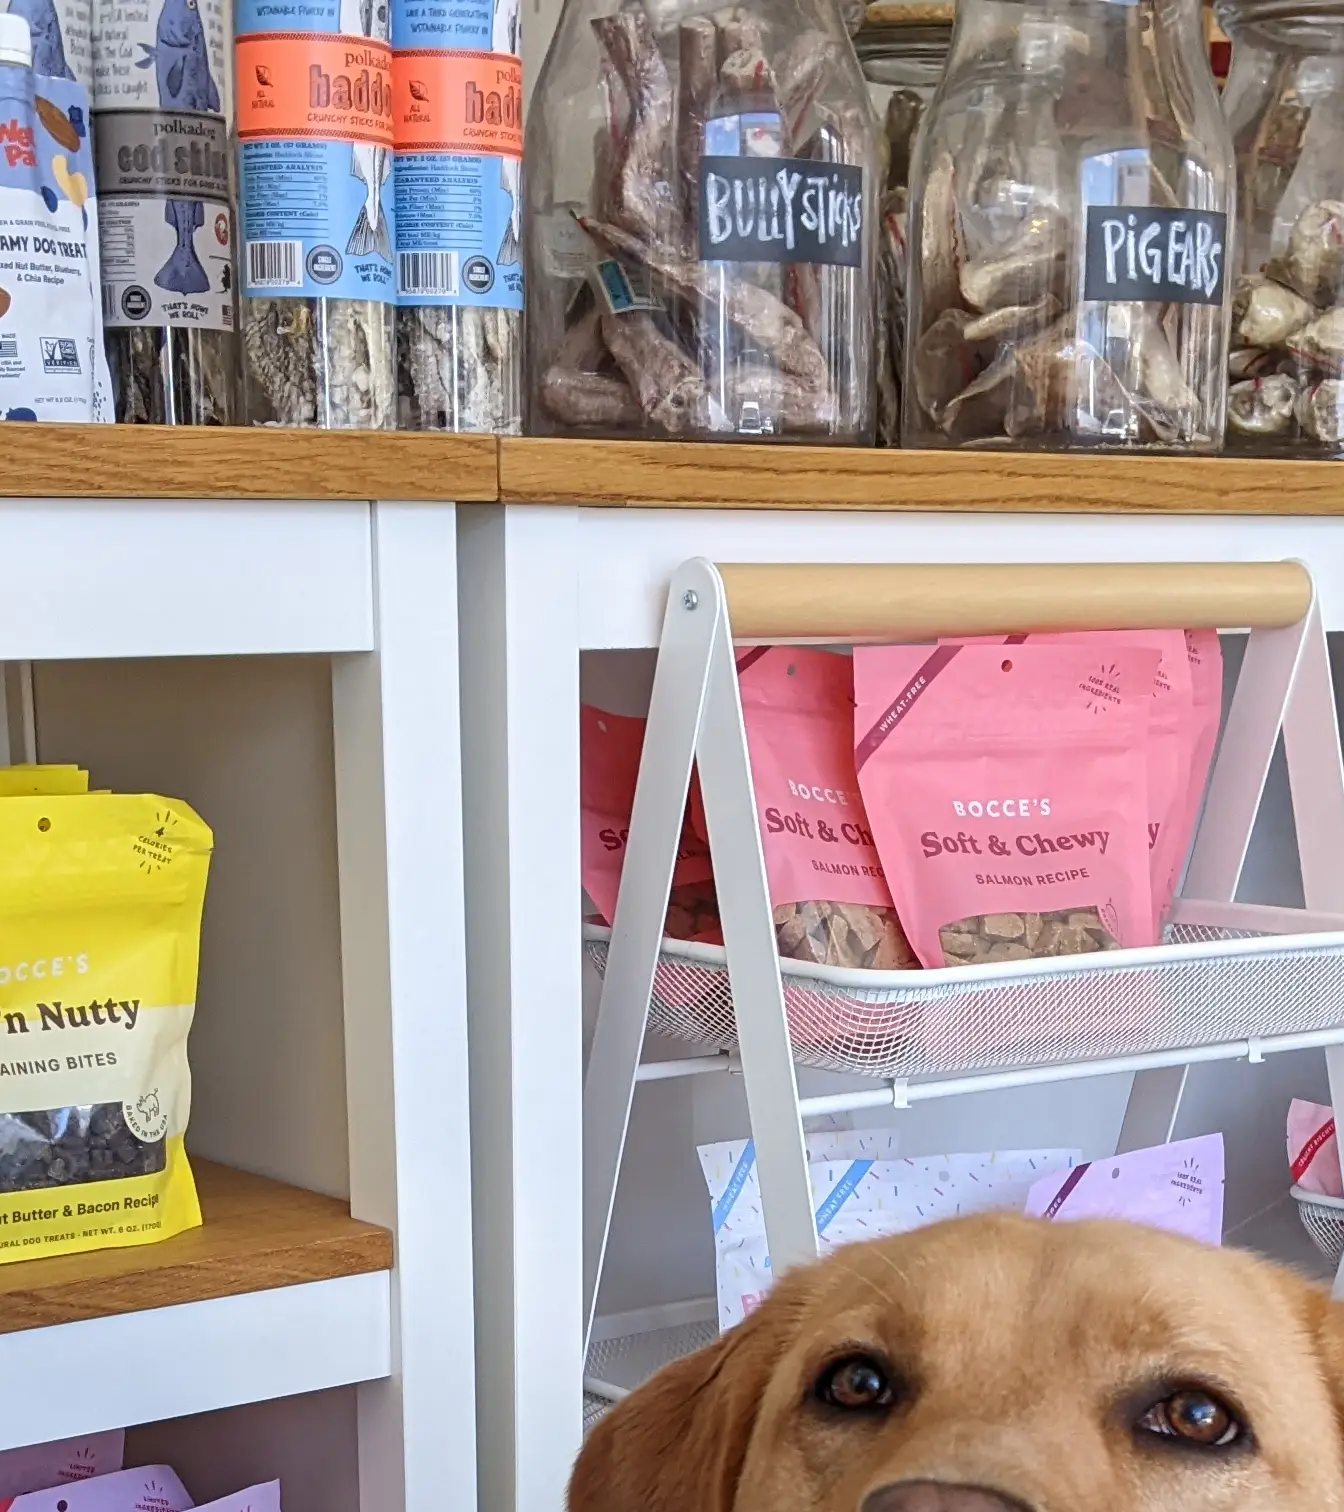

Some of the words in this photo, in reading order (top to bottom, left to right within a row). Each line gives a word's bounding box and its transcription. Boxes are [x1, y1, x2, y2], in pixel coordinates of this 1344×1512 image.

[153, 120, 216, 140] polkadog
[706, 168, 803, 249] BULLY
[33, 235, 57, 256] DOG
[57, 241, 87, 258] TREAT
[15, 261, 28, 271] Nut
[1168, 220, 1221, 298] EARS
[24, 273, 41, 283] Chia
[879, 675, 927, 732] WHEAT-FREE
[953, 798, 1052, 818] BOCCE'S
[765, 807, 814, 840] Soft
[817, 820, 838, 843] &
[920, 831, 982, 858] Soft
[987, 834, 1011, 857] &
[1015, 830, 1110, 857] Chewy
[812, 859, 859, 877] SALMON
[975, 874, 1032, 887] SALMON
[1037, 867, 1090, 885] RECIPE
[39, 998, 141, 1033] Nutty
[66, 1052, 118, 1070] BITES
[12, 1208, 58, 1224] Butter
[62, 1205, 73, 1218] &
[77, 1200, 120, 1216] Bacon
[23, 1237, 41, 1247] DOG
[44, 1232, 75, 1244] TREATS
